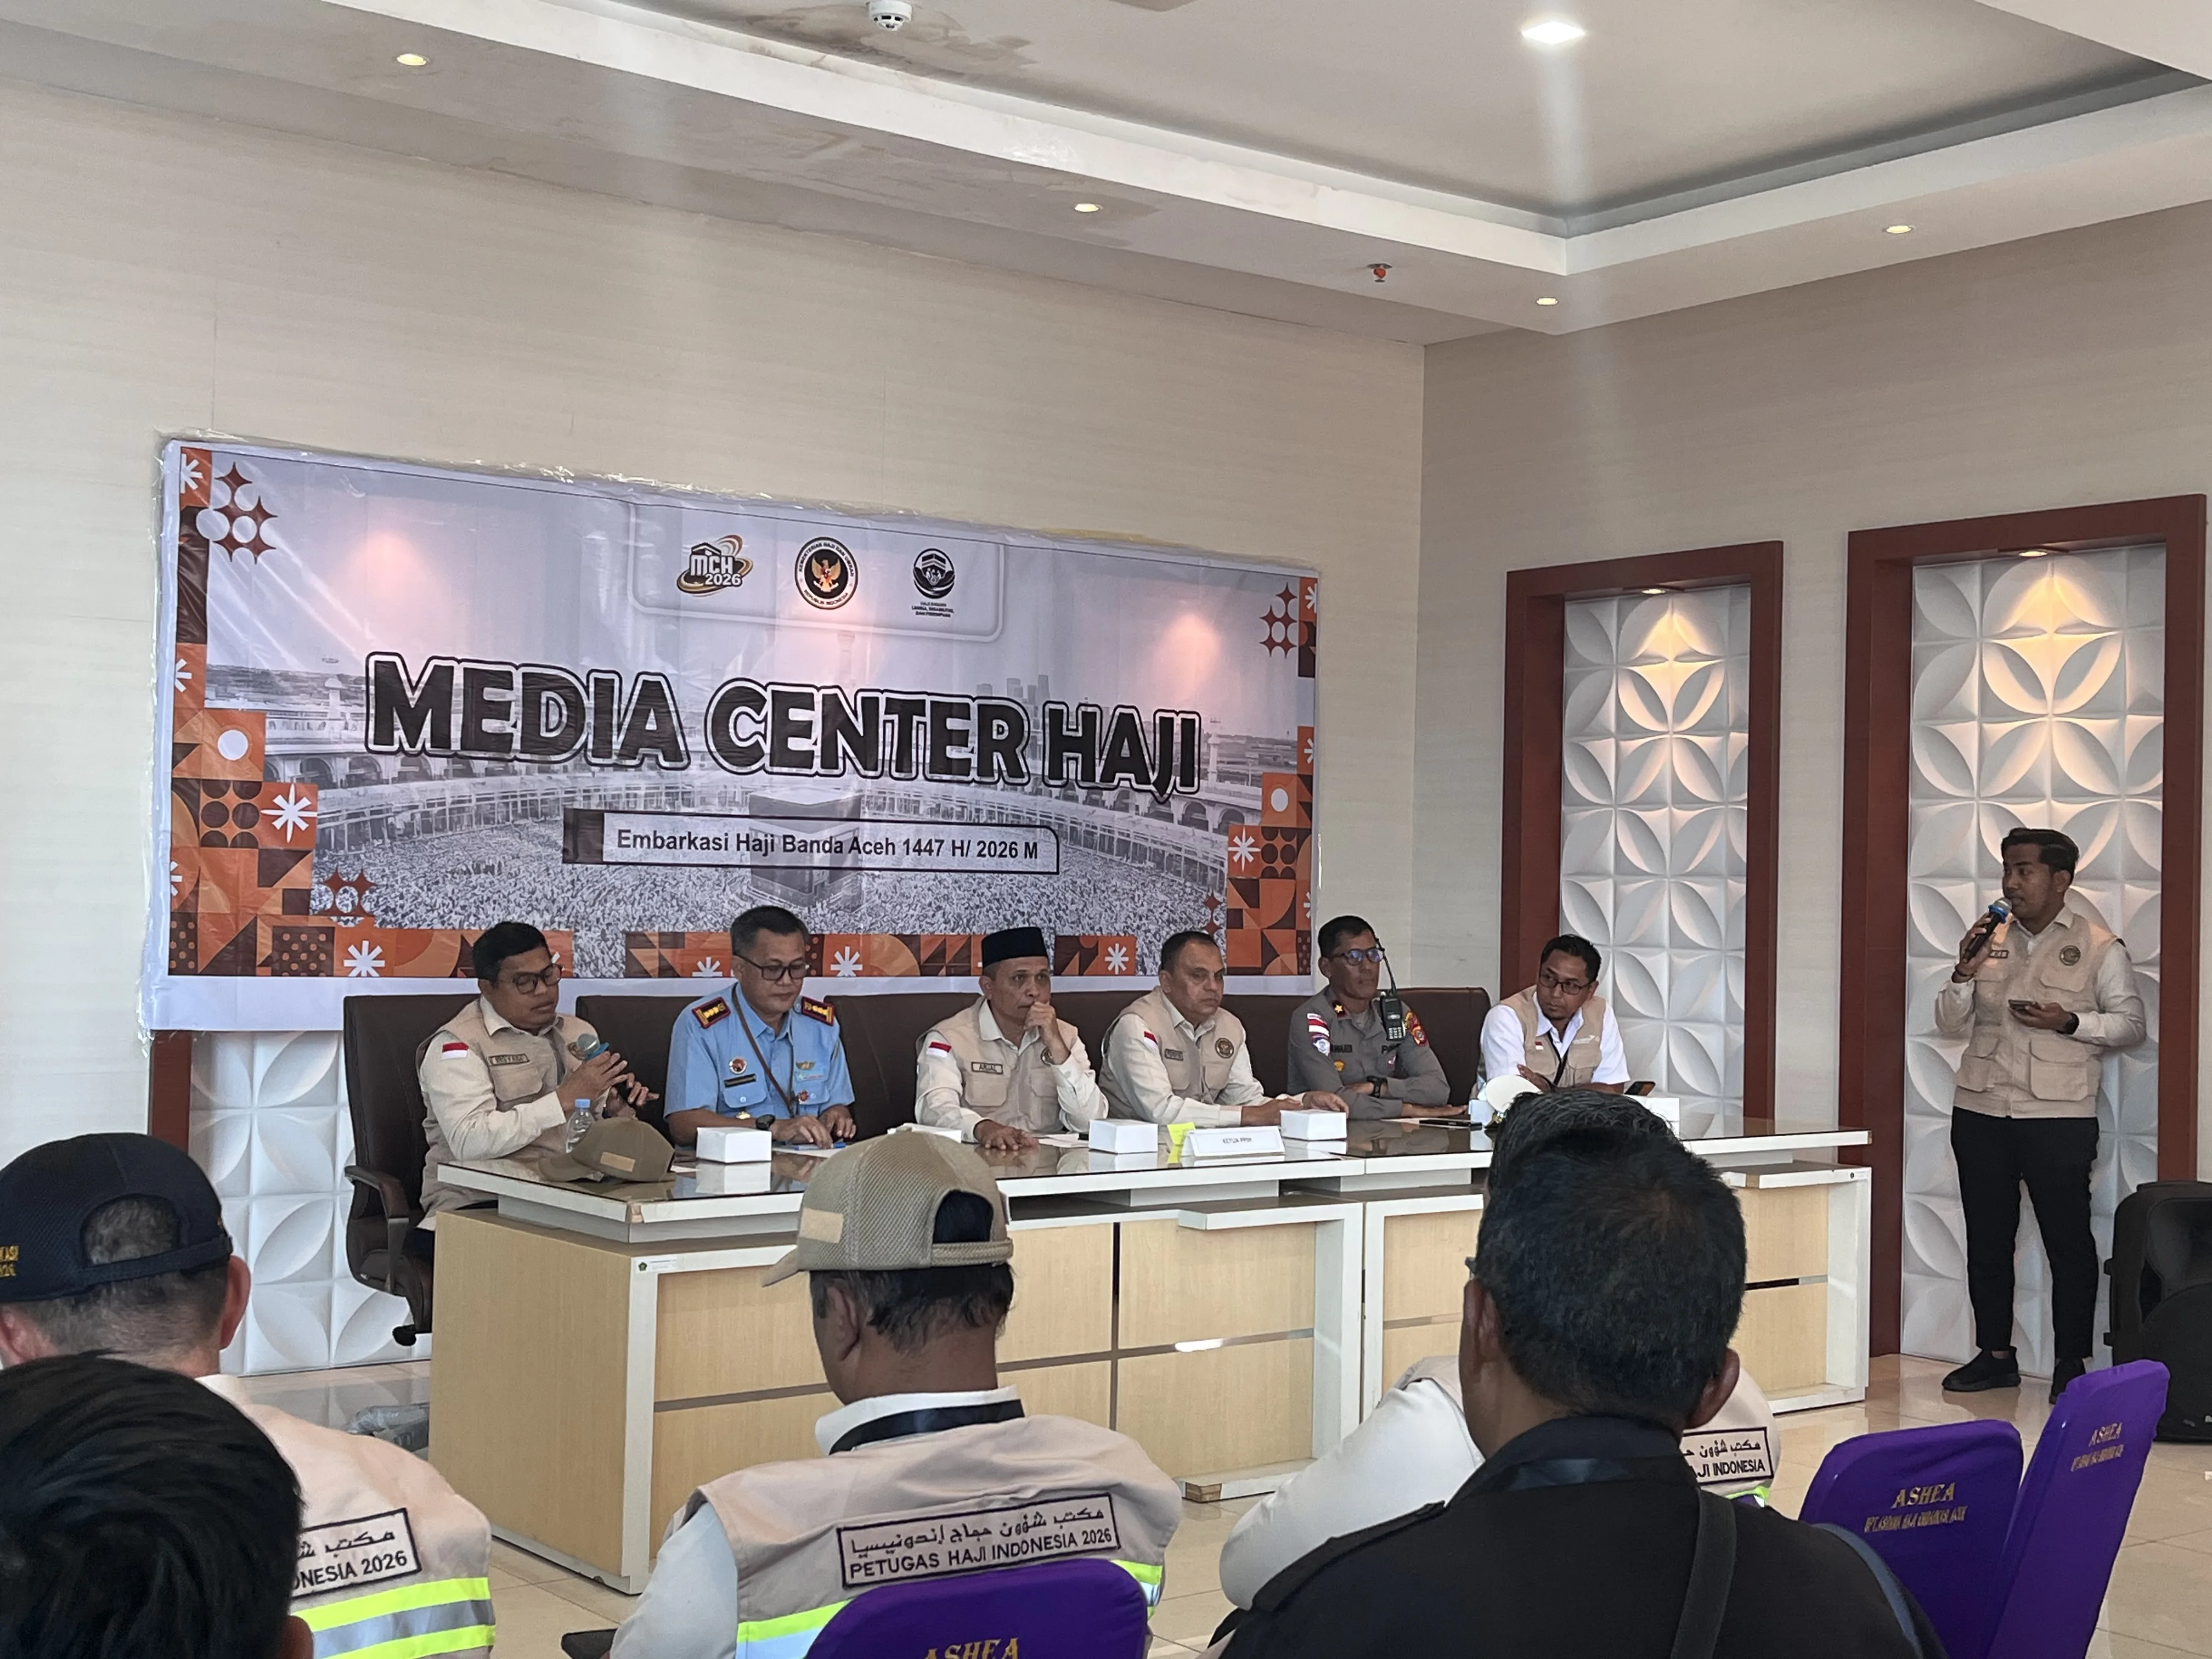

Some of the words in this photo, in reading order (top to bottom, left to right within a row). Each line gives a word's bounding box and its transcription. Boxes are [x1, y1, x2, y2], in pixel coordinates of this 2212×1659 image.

[690, 554, 733, 576] MCH
[705, 574, 741, 585] 2026
[366, 651, 690, 771] MEDIA
[704, 678, 1031, 786] CENTER
[1043, 701, 1201, 803] HAJI
[617, 828, 729, 851] Embarkasi
[736, 832, 775, 857] Haji
[783, 834, 843, 854] Banda
[848, 836, 895, 855] Aceh
[903, 839, 944, 856] 1447
[952, 839, 970, 857] H/
[977, 840, 1018, 859] 2026
[1024, 842, 1038, 859] M
[2088, 1422, 2123, 1447] ASHEA
[1730, 1439, 1760, 1457] مكتب
[1712, 1458, 1765, 1476] INDONESIA
[1891, 1482, 1955, 1509] ASHEA
[1000, 1511, 1047, 1537] شؤون
[1053, 1508, 1104, 1530] مكتب
[325, 1531, 396, 1558] مكتب
[851, 1524, 945, 1559] إندونيسيا
[950, 1522, 992, 1543] حجاج
[850, 1553, 940, 1579] PETUGAS
[948, 1546, 986, 1566] HAJI
[992, 1532, 1079, 1560] INDONESIA
[1082, 1527, 1112, 1545] 2026
[294, 1561, 358, 1589] NESIA
[361, 1550, 407, 1575] 2026
